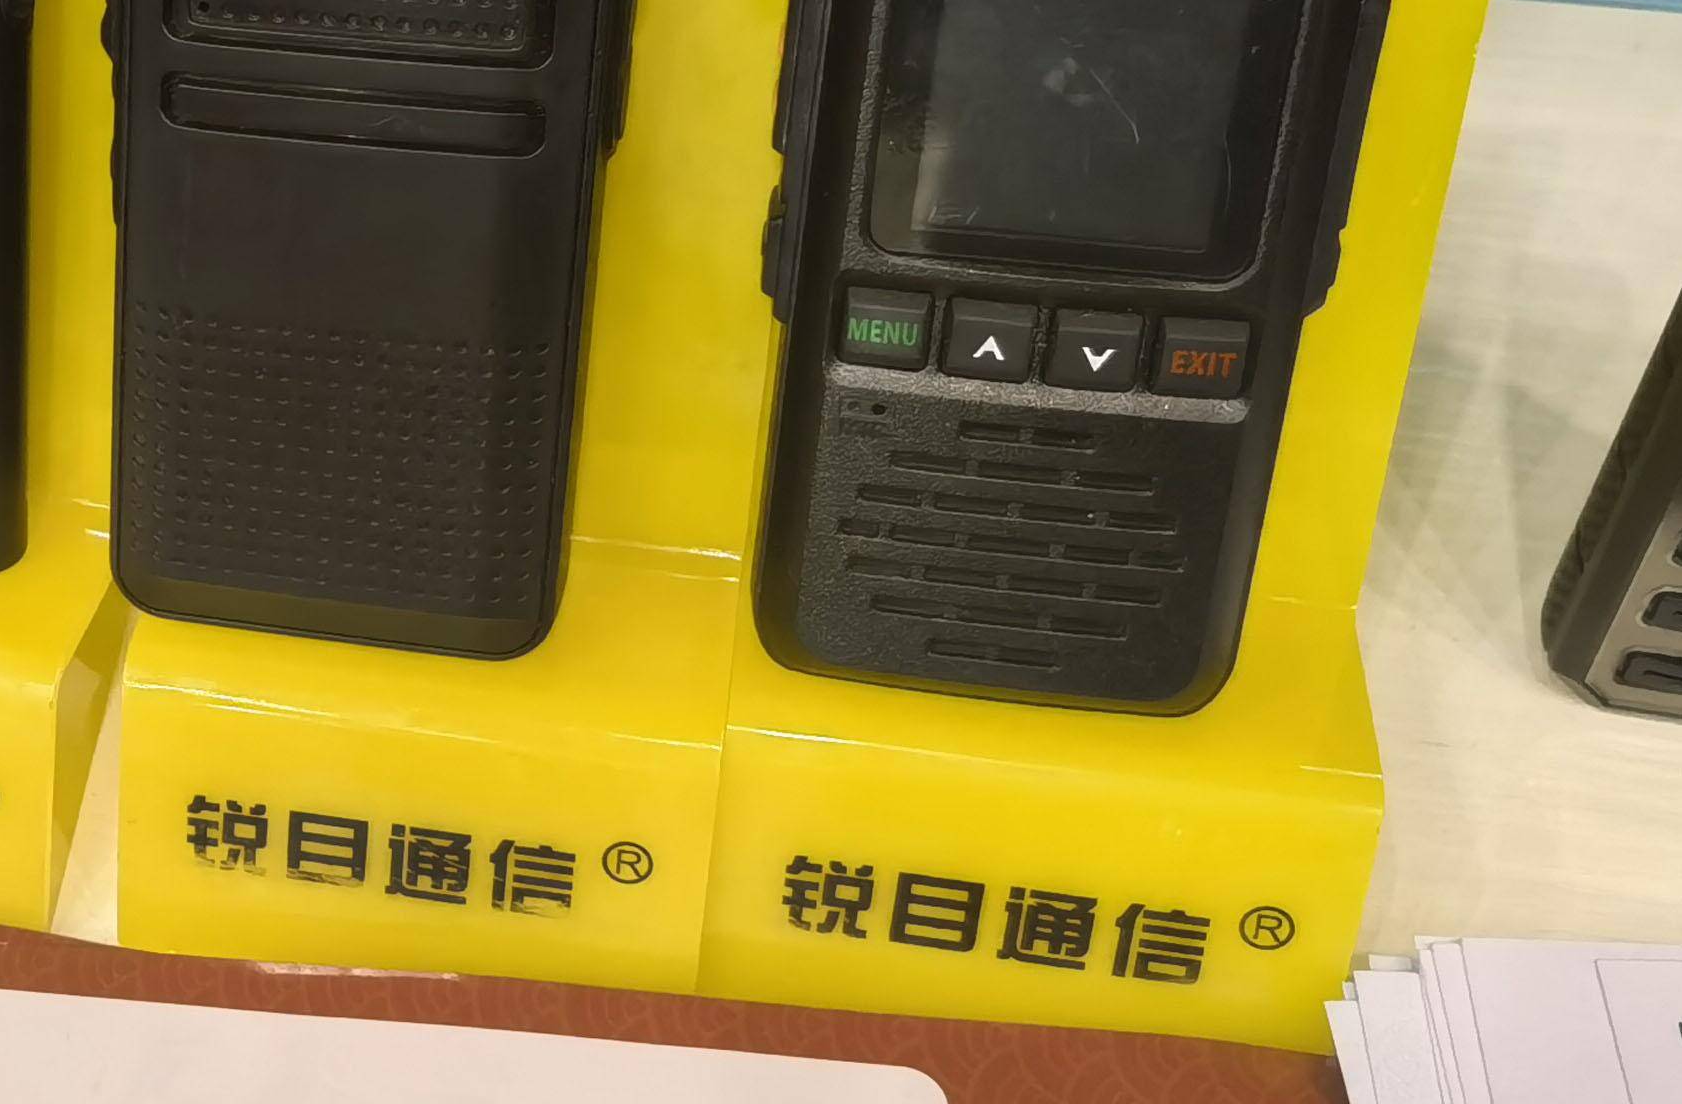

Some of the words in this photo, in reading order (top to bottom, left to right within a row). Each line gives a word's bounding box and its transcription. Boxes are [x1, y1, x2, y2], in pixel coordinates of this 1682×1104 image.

[846, 317, 919, 347] MENU
[1169, 349, 1239, 379] EXIT
[186, 794, 577, 919] 锐目通信
[781, 854, 1212, 986] 锐目通信
